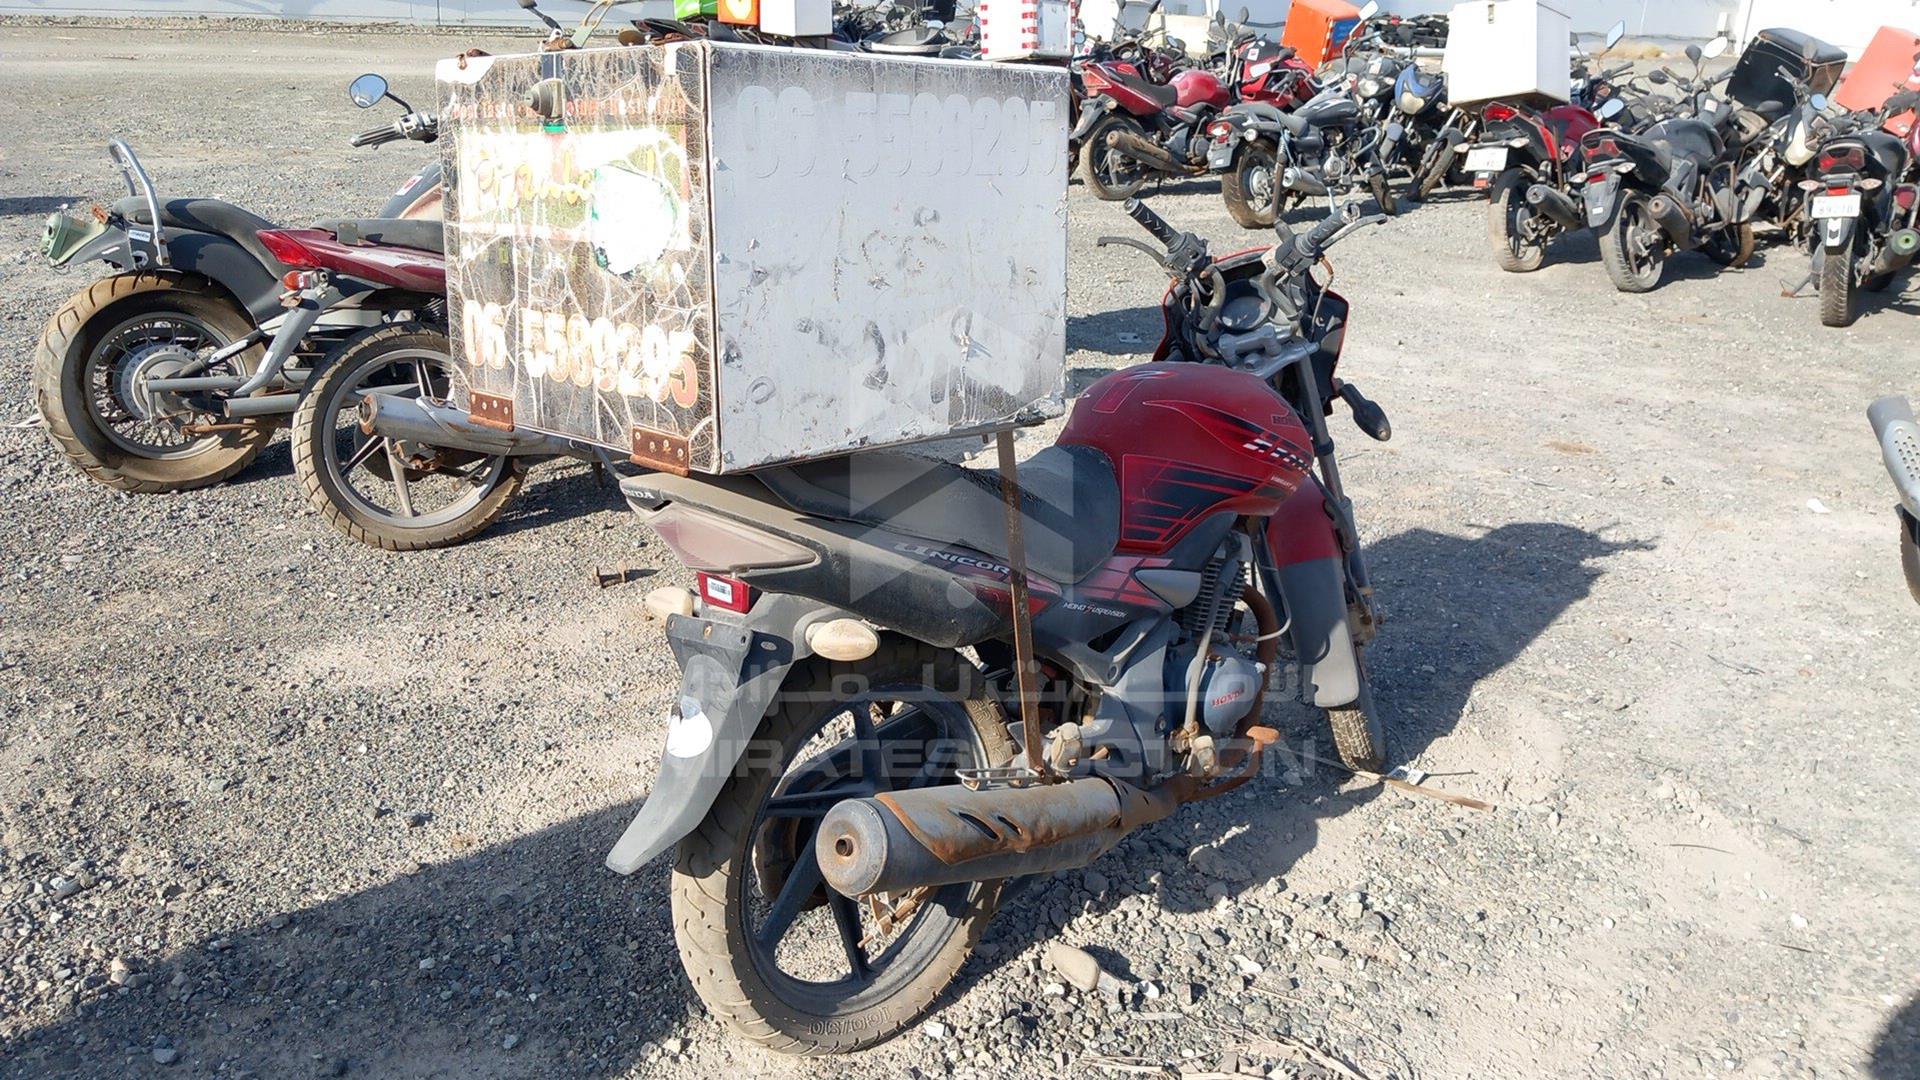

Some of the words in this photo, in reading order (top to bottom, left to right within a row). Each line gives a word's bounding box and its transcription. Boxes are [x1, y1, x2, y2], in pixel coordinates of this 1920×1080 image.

[737, 85, 816, 179] 06
[463, 300, 507, 370] 06
[521, 307, 698, 409] 5589295
[894, 542, 1010, 575] UNICOR
[1212, 687, 1245, 707] HONDA
